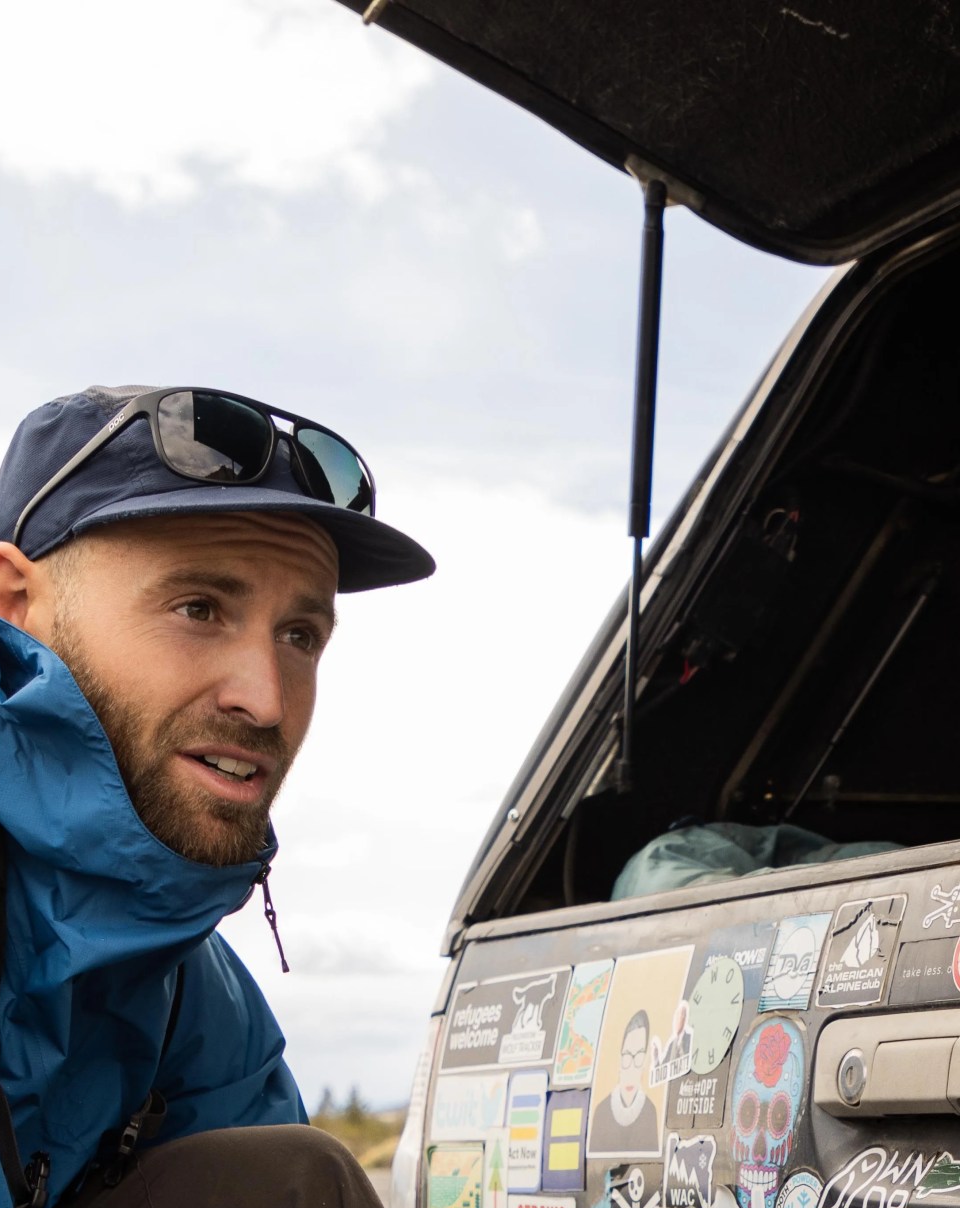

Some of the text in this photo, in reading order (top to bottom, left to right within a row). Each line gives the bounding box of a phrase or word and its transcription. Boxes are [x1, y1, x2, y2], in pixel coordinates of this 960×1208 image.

[825, 967, 884, 984] AMERICAN
[829, 962, 843, 972] the
[902, 967, 920, 979] take
[823, 979, 880, 994] ALPINE club
[453, 1004, 503, 1030] refugees
[450, 1027, 499, 1050] welcome
[655, 1065, 668, 1083] DID
[669, 1055, 690, 1077] THAT!
[676, 1097, 716, 1115] OUTSIDE
[520, 1147, 538, 1160] Now
[670, 1188, 696, 1206] WAC
